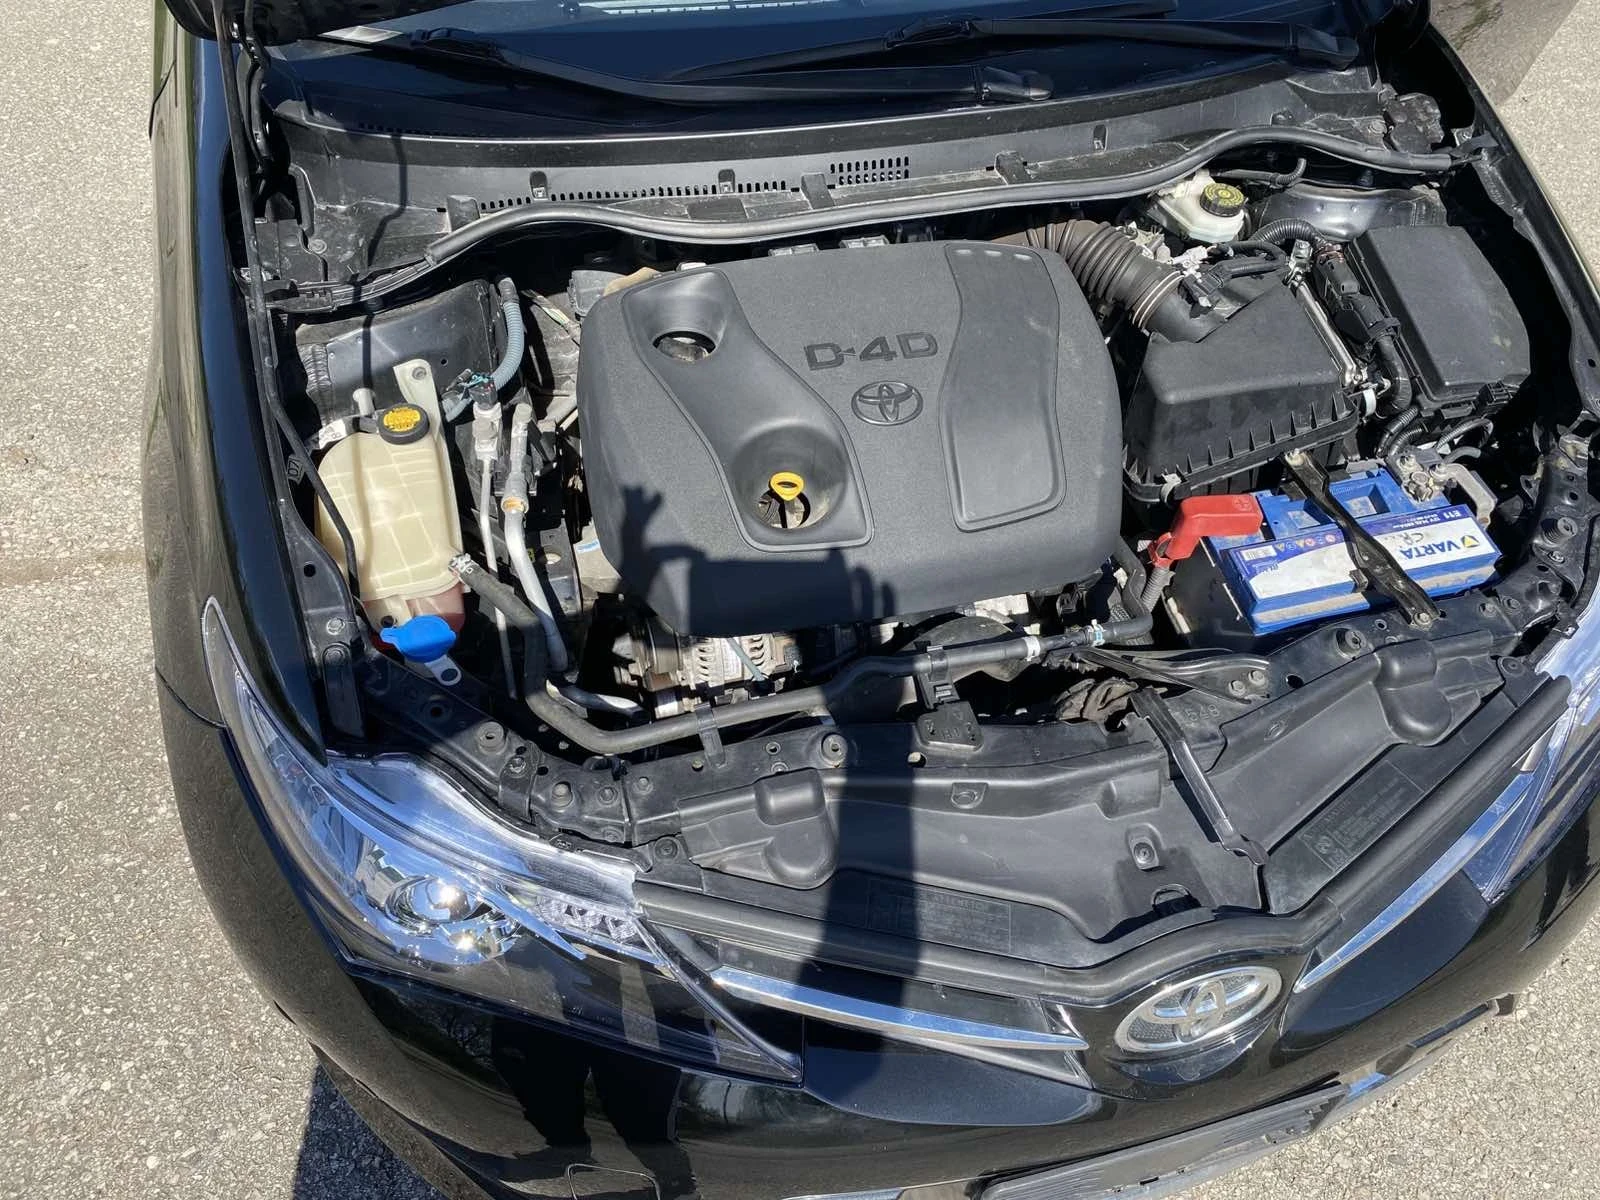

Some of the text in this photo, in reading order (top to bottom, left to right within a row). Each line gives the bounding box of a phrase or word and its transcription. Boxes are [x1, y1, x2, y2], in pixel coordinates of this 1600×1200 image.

[803, 332, 939, 371] D-4D
[1443, 510, 1461, 520] E11
[1399, 539, 1460, 559] VARTA
